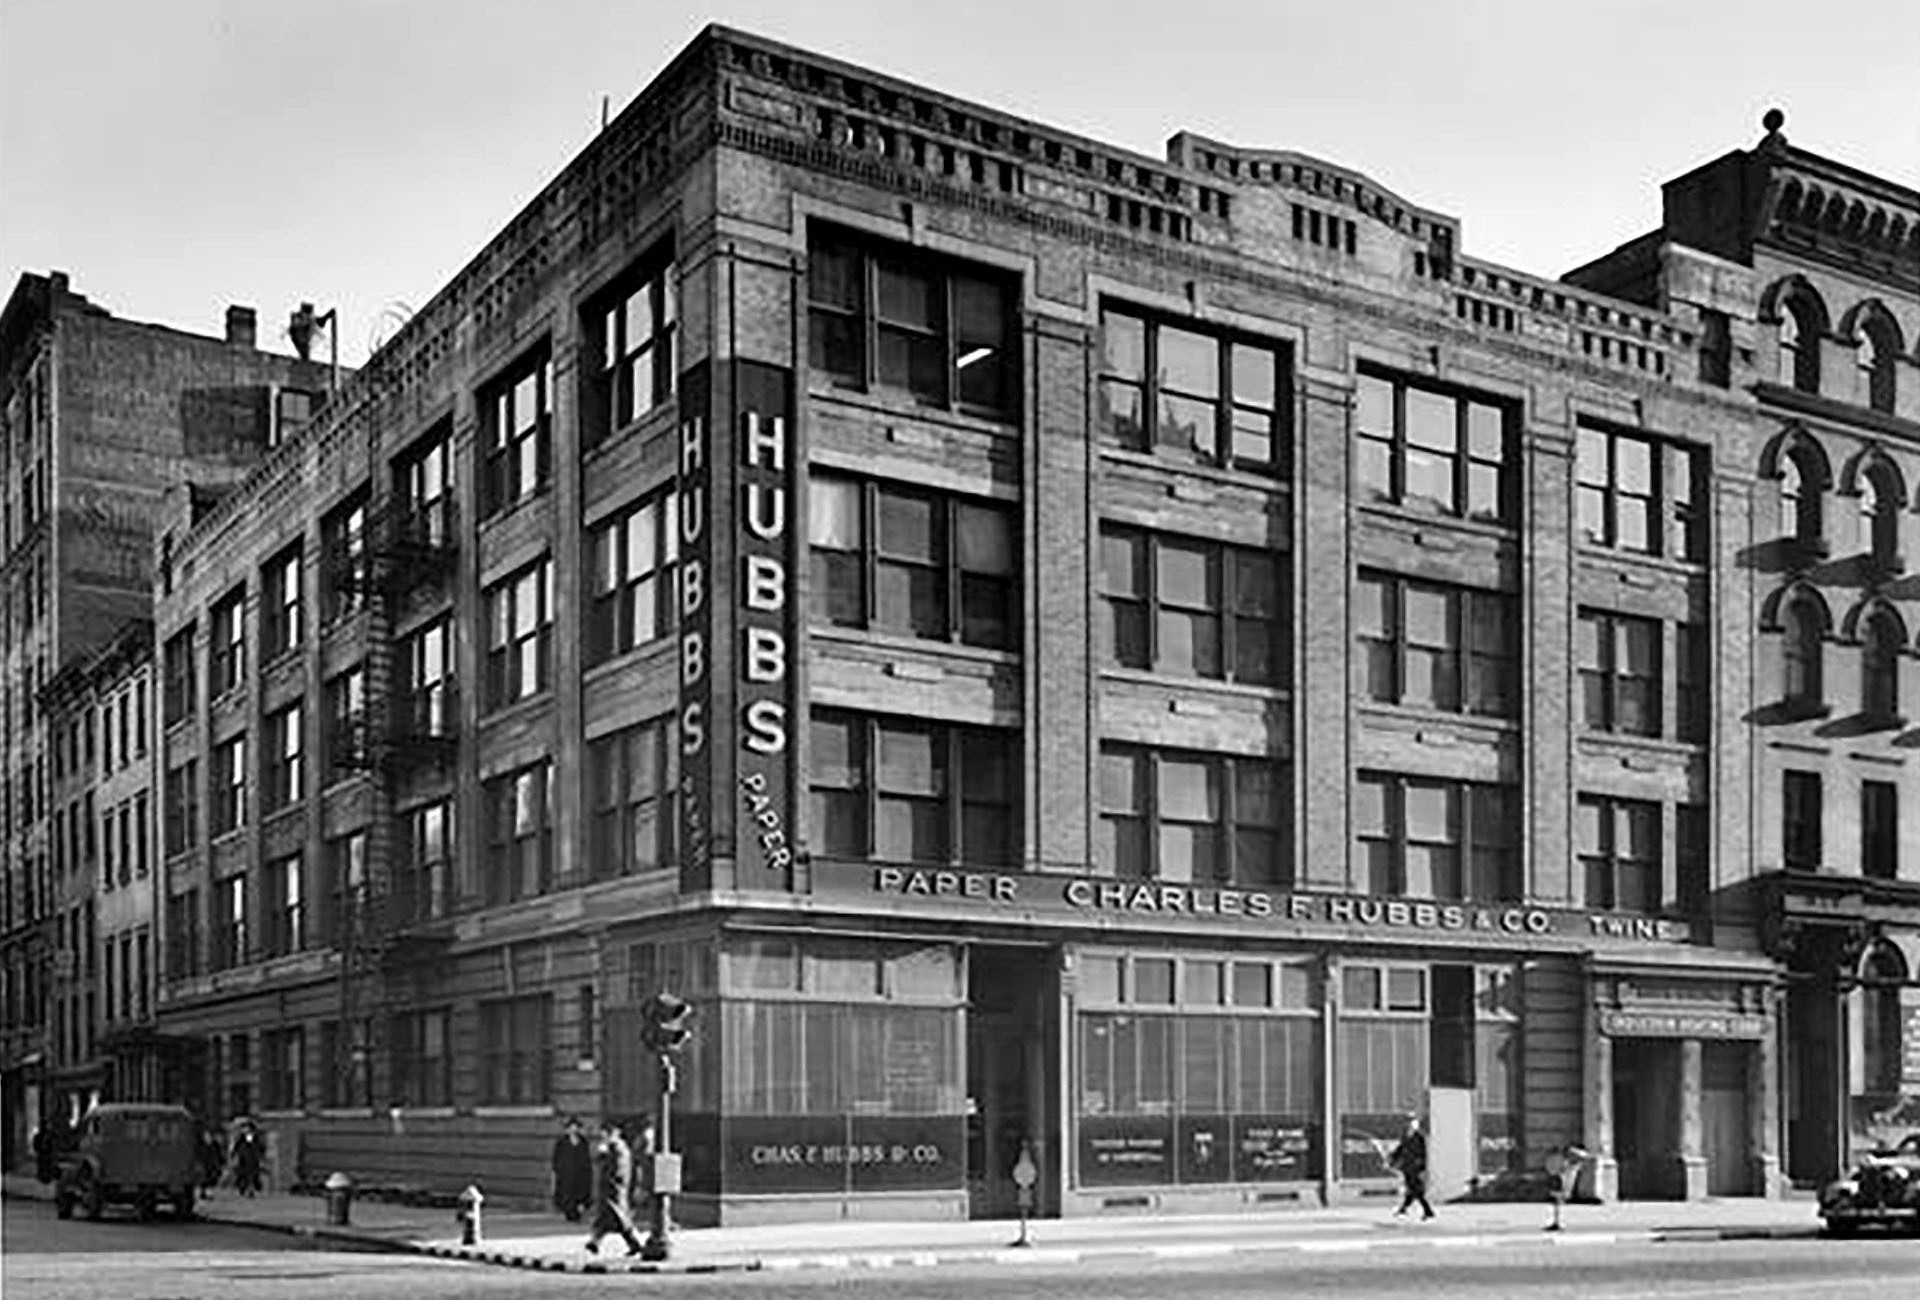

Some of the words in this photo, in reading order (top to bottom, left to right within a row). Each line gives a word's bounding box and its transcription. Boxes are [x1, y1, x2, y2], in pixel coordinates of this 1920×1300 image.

[682, 417, 703, 755] HUBBS
[747, 411, 786, 754] HUBBS
[744, 773, 791, 868] PAPER
[879, 868, 1018, 902] PAPER
[1067, 880, 1272, 916] CHARLES
[1330, 898, 1464, 928] HUBBS
[1475, 909, 1491, 928] &
[1590, 916, 1673, 940] TWINE
